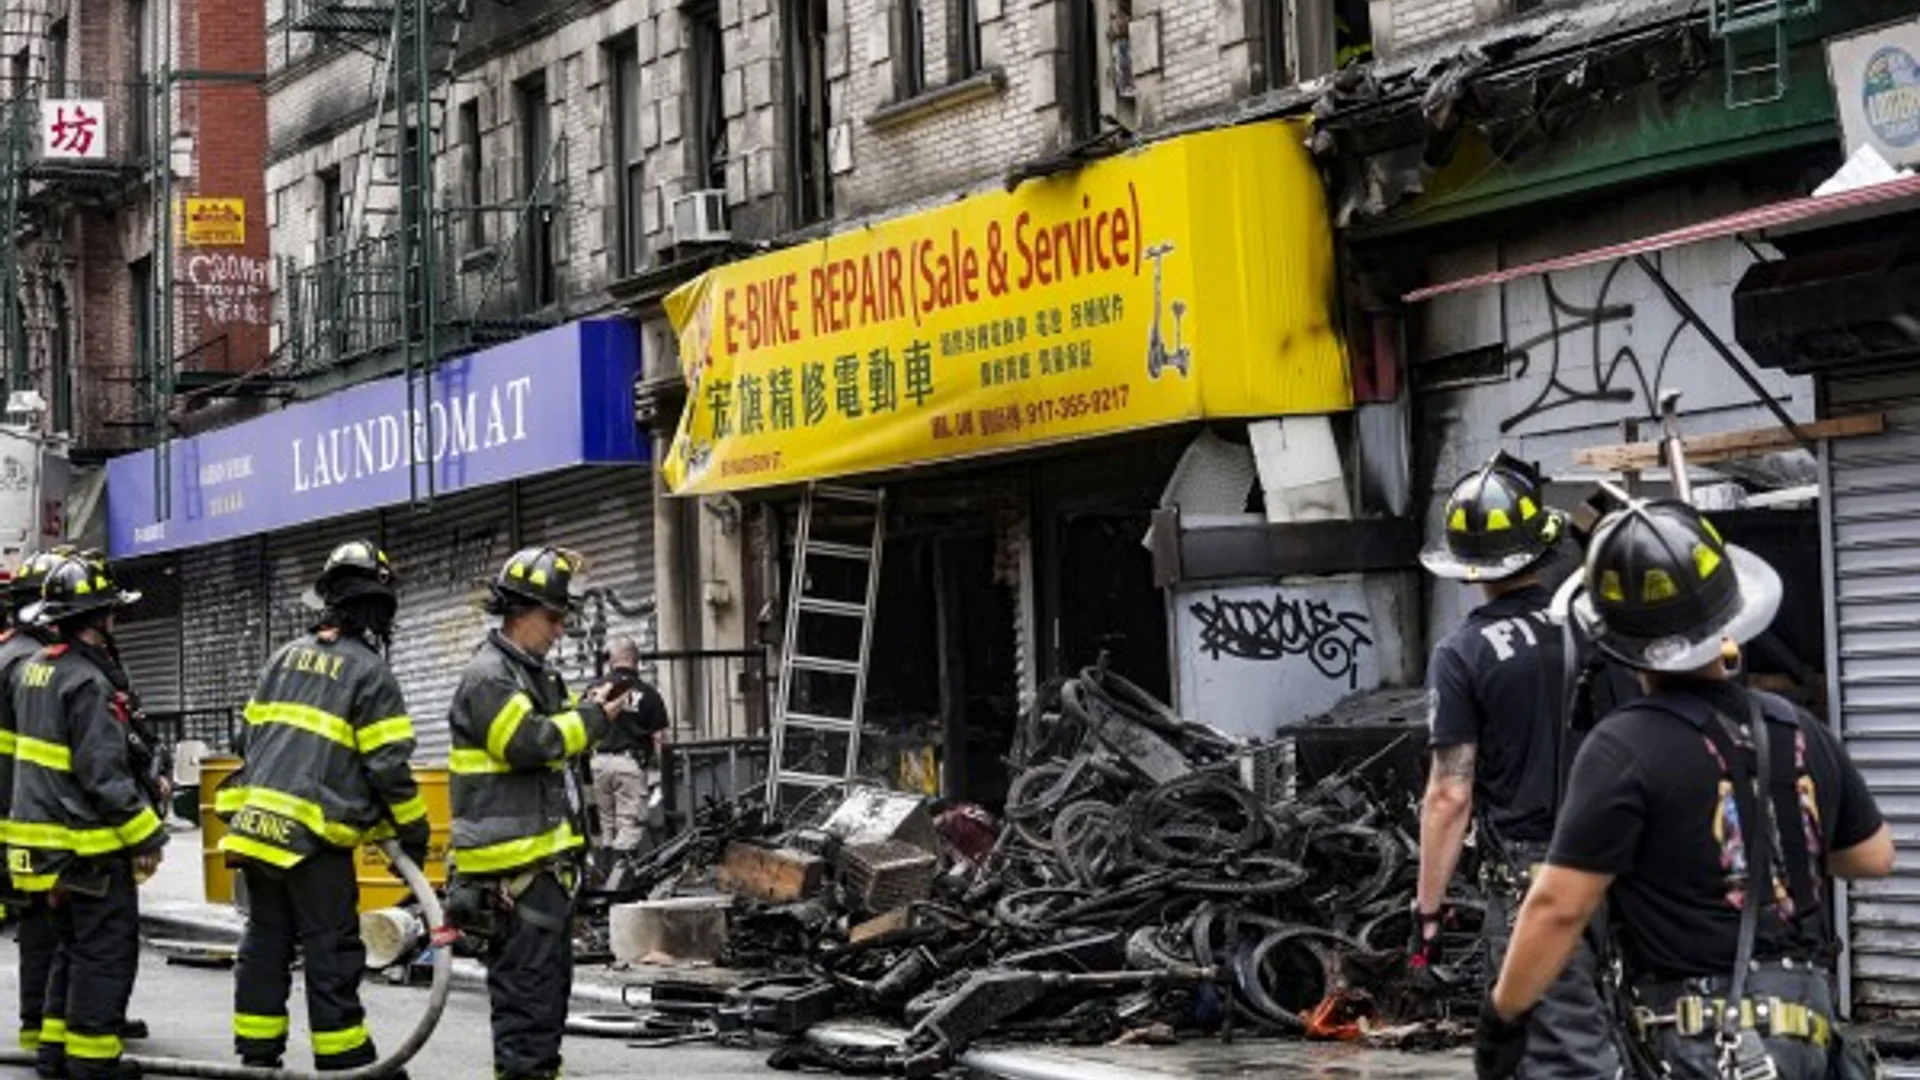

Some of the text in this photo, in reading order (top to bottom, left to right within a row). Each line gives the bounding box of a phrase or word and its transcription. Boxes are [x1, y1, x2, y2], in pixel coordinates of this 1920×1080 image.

[51, 105, 97, 156] 坊
[724, 273, 800, 356] E-BIKE
[811, 244, 905, 337] REPAIR
[911, 228, 979, 327] (Sale
[987, 220, 1010, 298] &
[1015, 181, 1141, 291] Service)
[292, 376, 531, 493] LAUNDROMAT
[707, 340, 934, 438] 宏旗精修電動車
